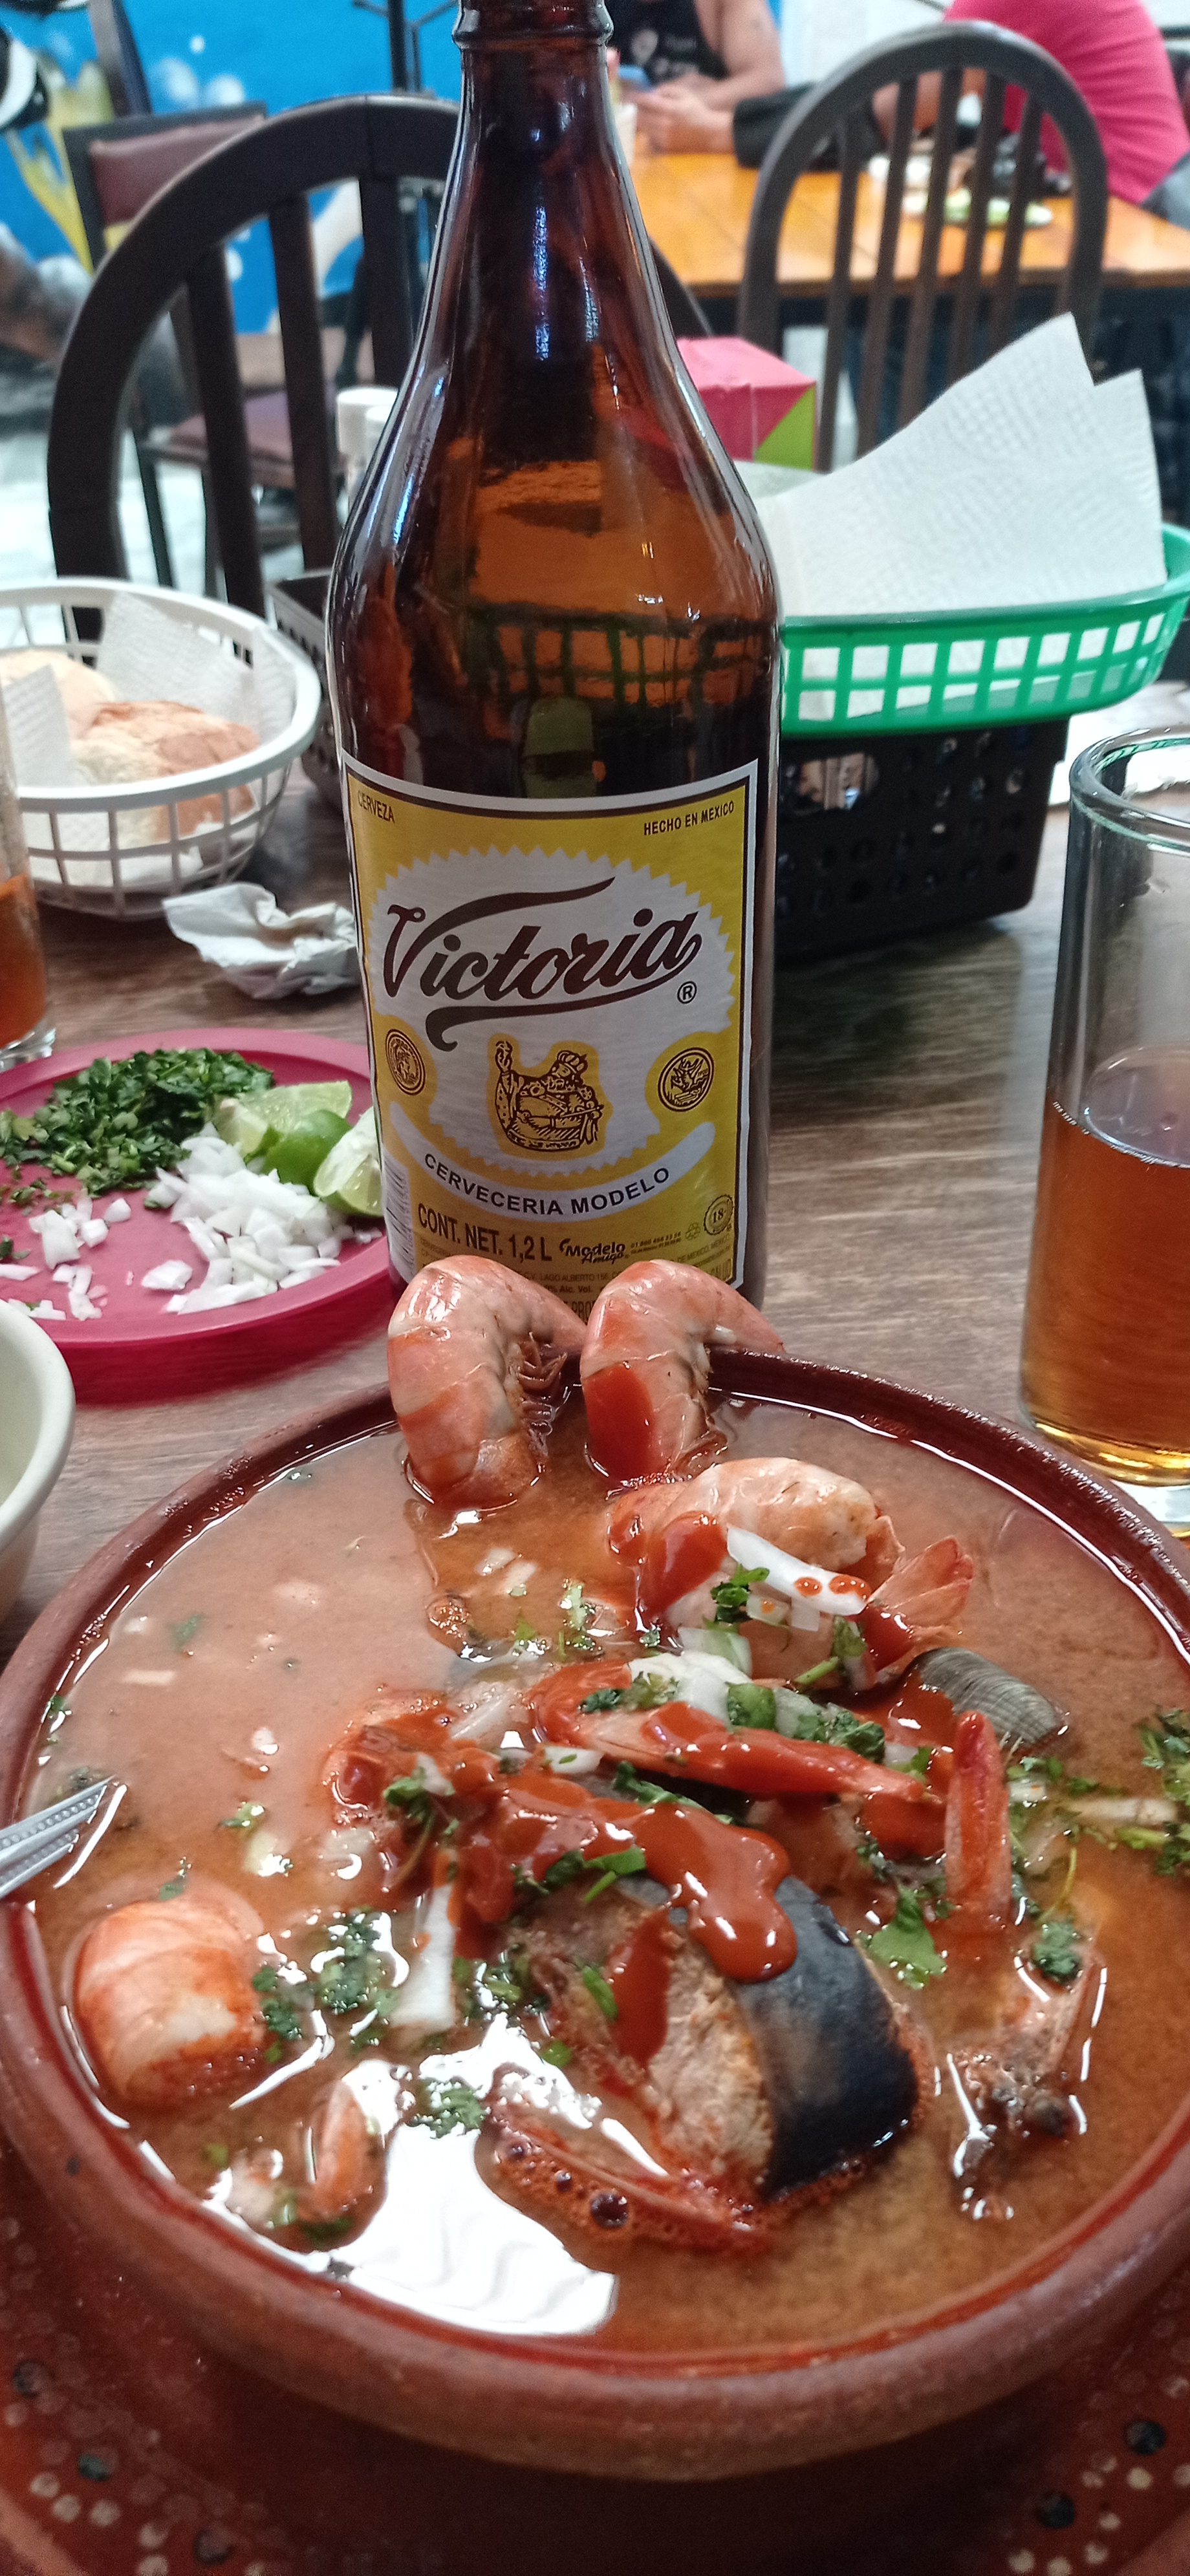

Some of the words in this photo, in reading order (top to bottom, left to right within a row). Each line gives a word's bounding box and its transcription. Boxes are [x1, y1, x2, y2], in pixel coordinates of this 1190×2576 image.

[358, 789, 395, 824] CERVEZA
[644, 817, 682, 836] HECHO
[685, 812, 698, 828] EN
[700, 800, 735, 824] MEXICO
[384, 876, 703, 1051] Victoria
[425, 1153, 563, 1215] CERVECERIA
[571, 1167, 669, 1214] MODELO
[418, 1203, 461, 1244] CONT.
[464, 1223, 503, 1256] NET.
[508, 1234, 536, 1263] 1,2
[540, 1236, 553, 1261] L
[559, 1238, 626, 1257] Modelo
[581, 1251, 625, 1265] Amigo
